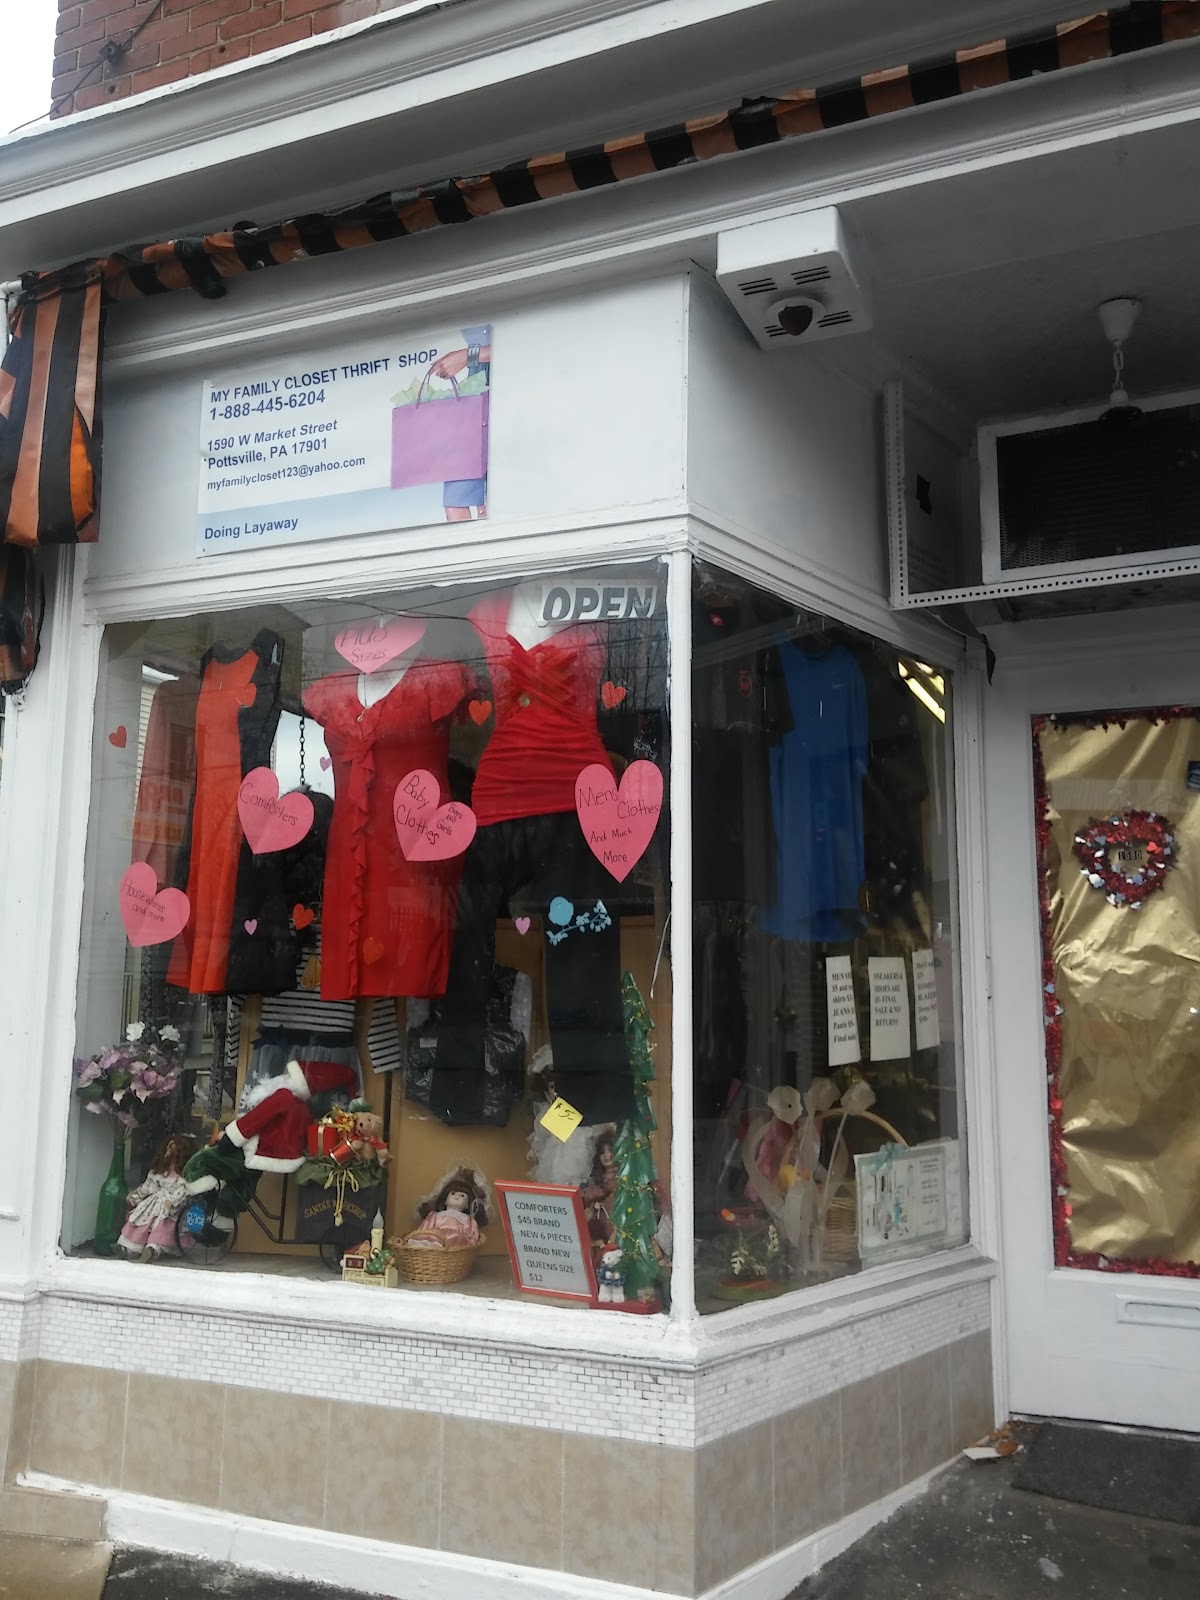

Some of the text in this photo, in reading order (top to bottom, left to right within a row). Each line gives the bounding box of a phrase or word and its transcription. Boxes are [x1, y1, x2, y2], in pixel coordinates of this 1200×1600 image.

[210, 348, 438, 403] MY FAMILY CLOSET THRIFT SHOP
[209, 388, 326, 421] 1-888-445-6204
[207, 419, 338, 452] 1590 W Market Street
[208, 438, 328, 470] Pottsville, PA 17901
[207, 456, 366, 490] myfamilycloset123@yahoo.com
[204, 517, 299, 540] Doing Layaway
[542, 586, 654, 621] OPEN
[351, 648, 388, 664] Sizes
[403, 774, 430, 810] Baby
[579, 786, 619, 809] Mens
[240, 782, 298, 826] Comforters
[616, 798, 659, 820] Clothes
[396, 804, 440, 845] Clothes
[590, 827, 633, 844] And Much
[603, 850, 628, 864] More
[514, 1201, 568, 1216] COMFORTERS
[517, 1215, 560, 1228] $45 BRAND
[520, 1229, 573, 1244] NEW 6 PIECES
[523, 1244, 571, 1259] BRAND NEW
[526, 1260, 575, 1274] QUEENS SIZE
[528, 1273, 543, 1282] $12
